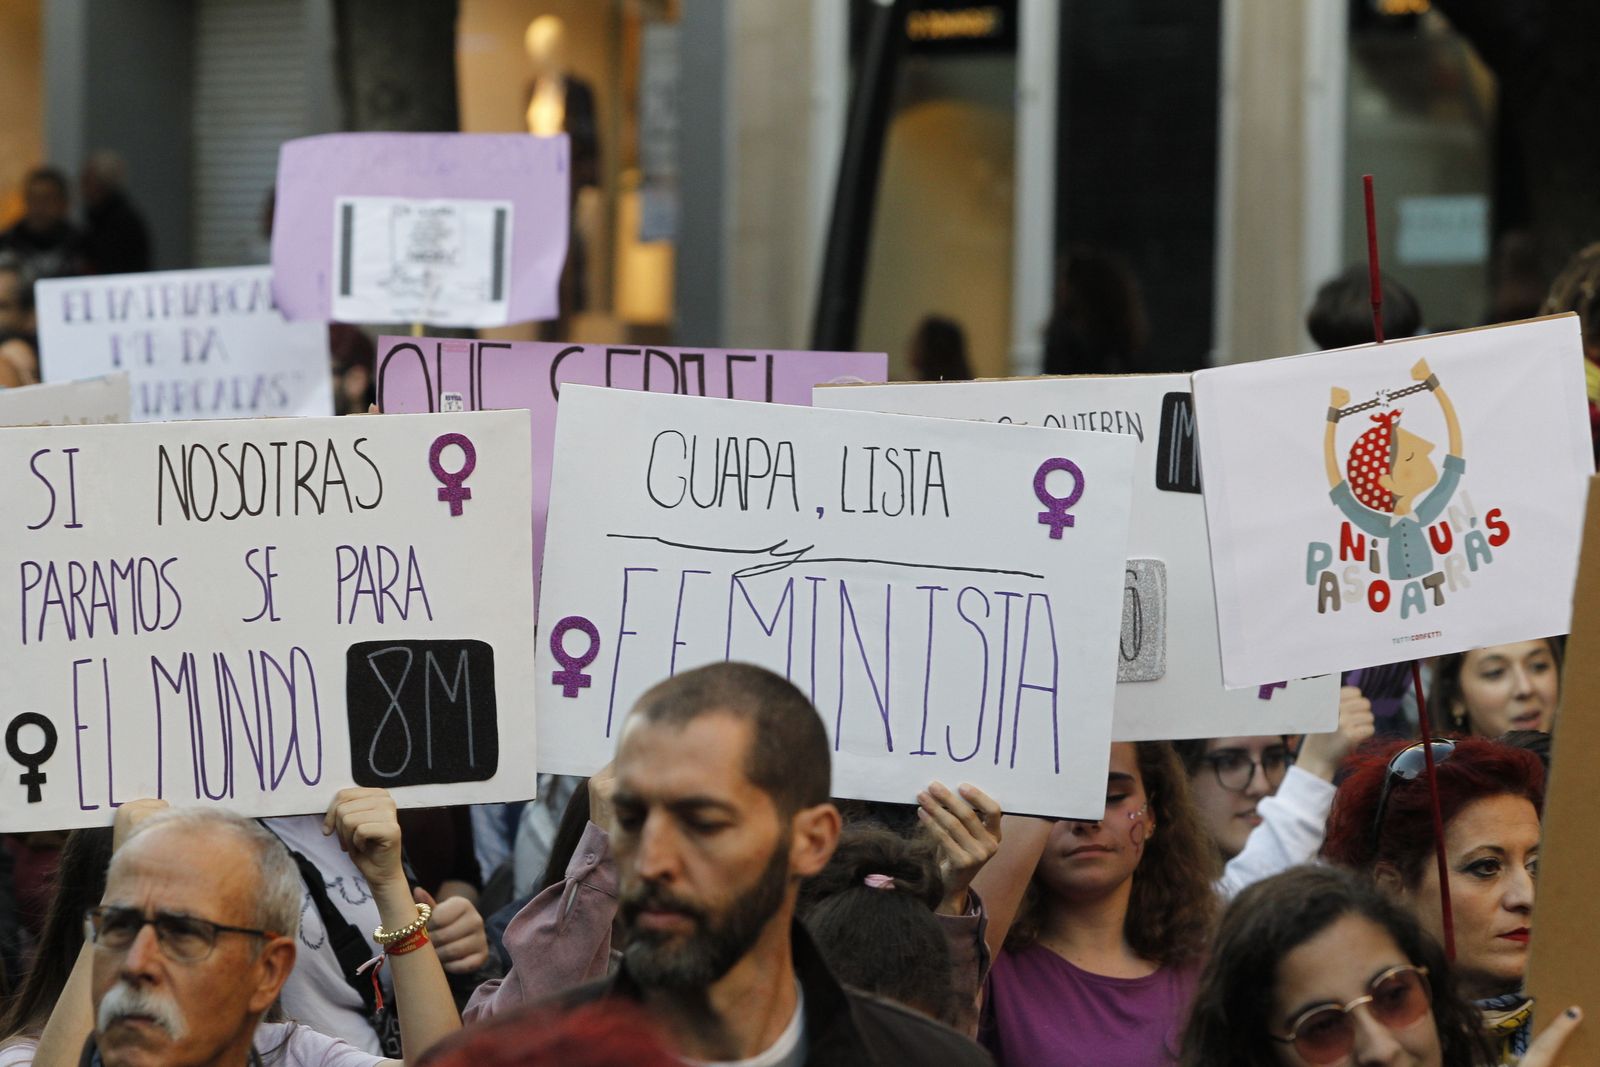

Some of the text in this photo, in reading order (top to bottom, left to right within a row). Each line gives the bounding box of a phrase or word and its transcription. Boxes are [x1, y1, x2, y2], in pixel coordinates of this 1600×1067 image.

[27, 437, 383, 529] SI NOSOTRAS
[841, 446, 949, 517] LISTA
[21, 544, 433, 645] PARAMOS SE PARA
[1306, 541, 1391, 614] PASO
[73, 646, 475, 811] EL MUNDO 8M
